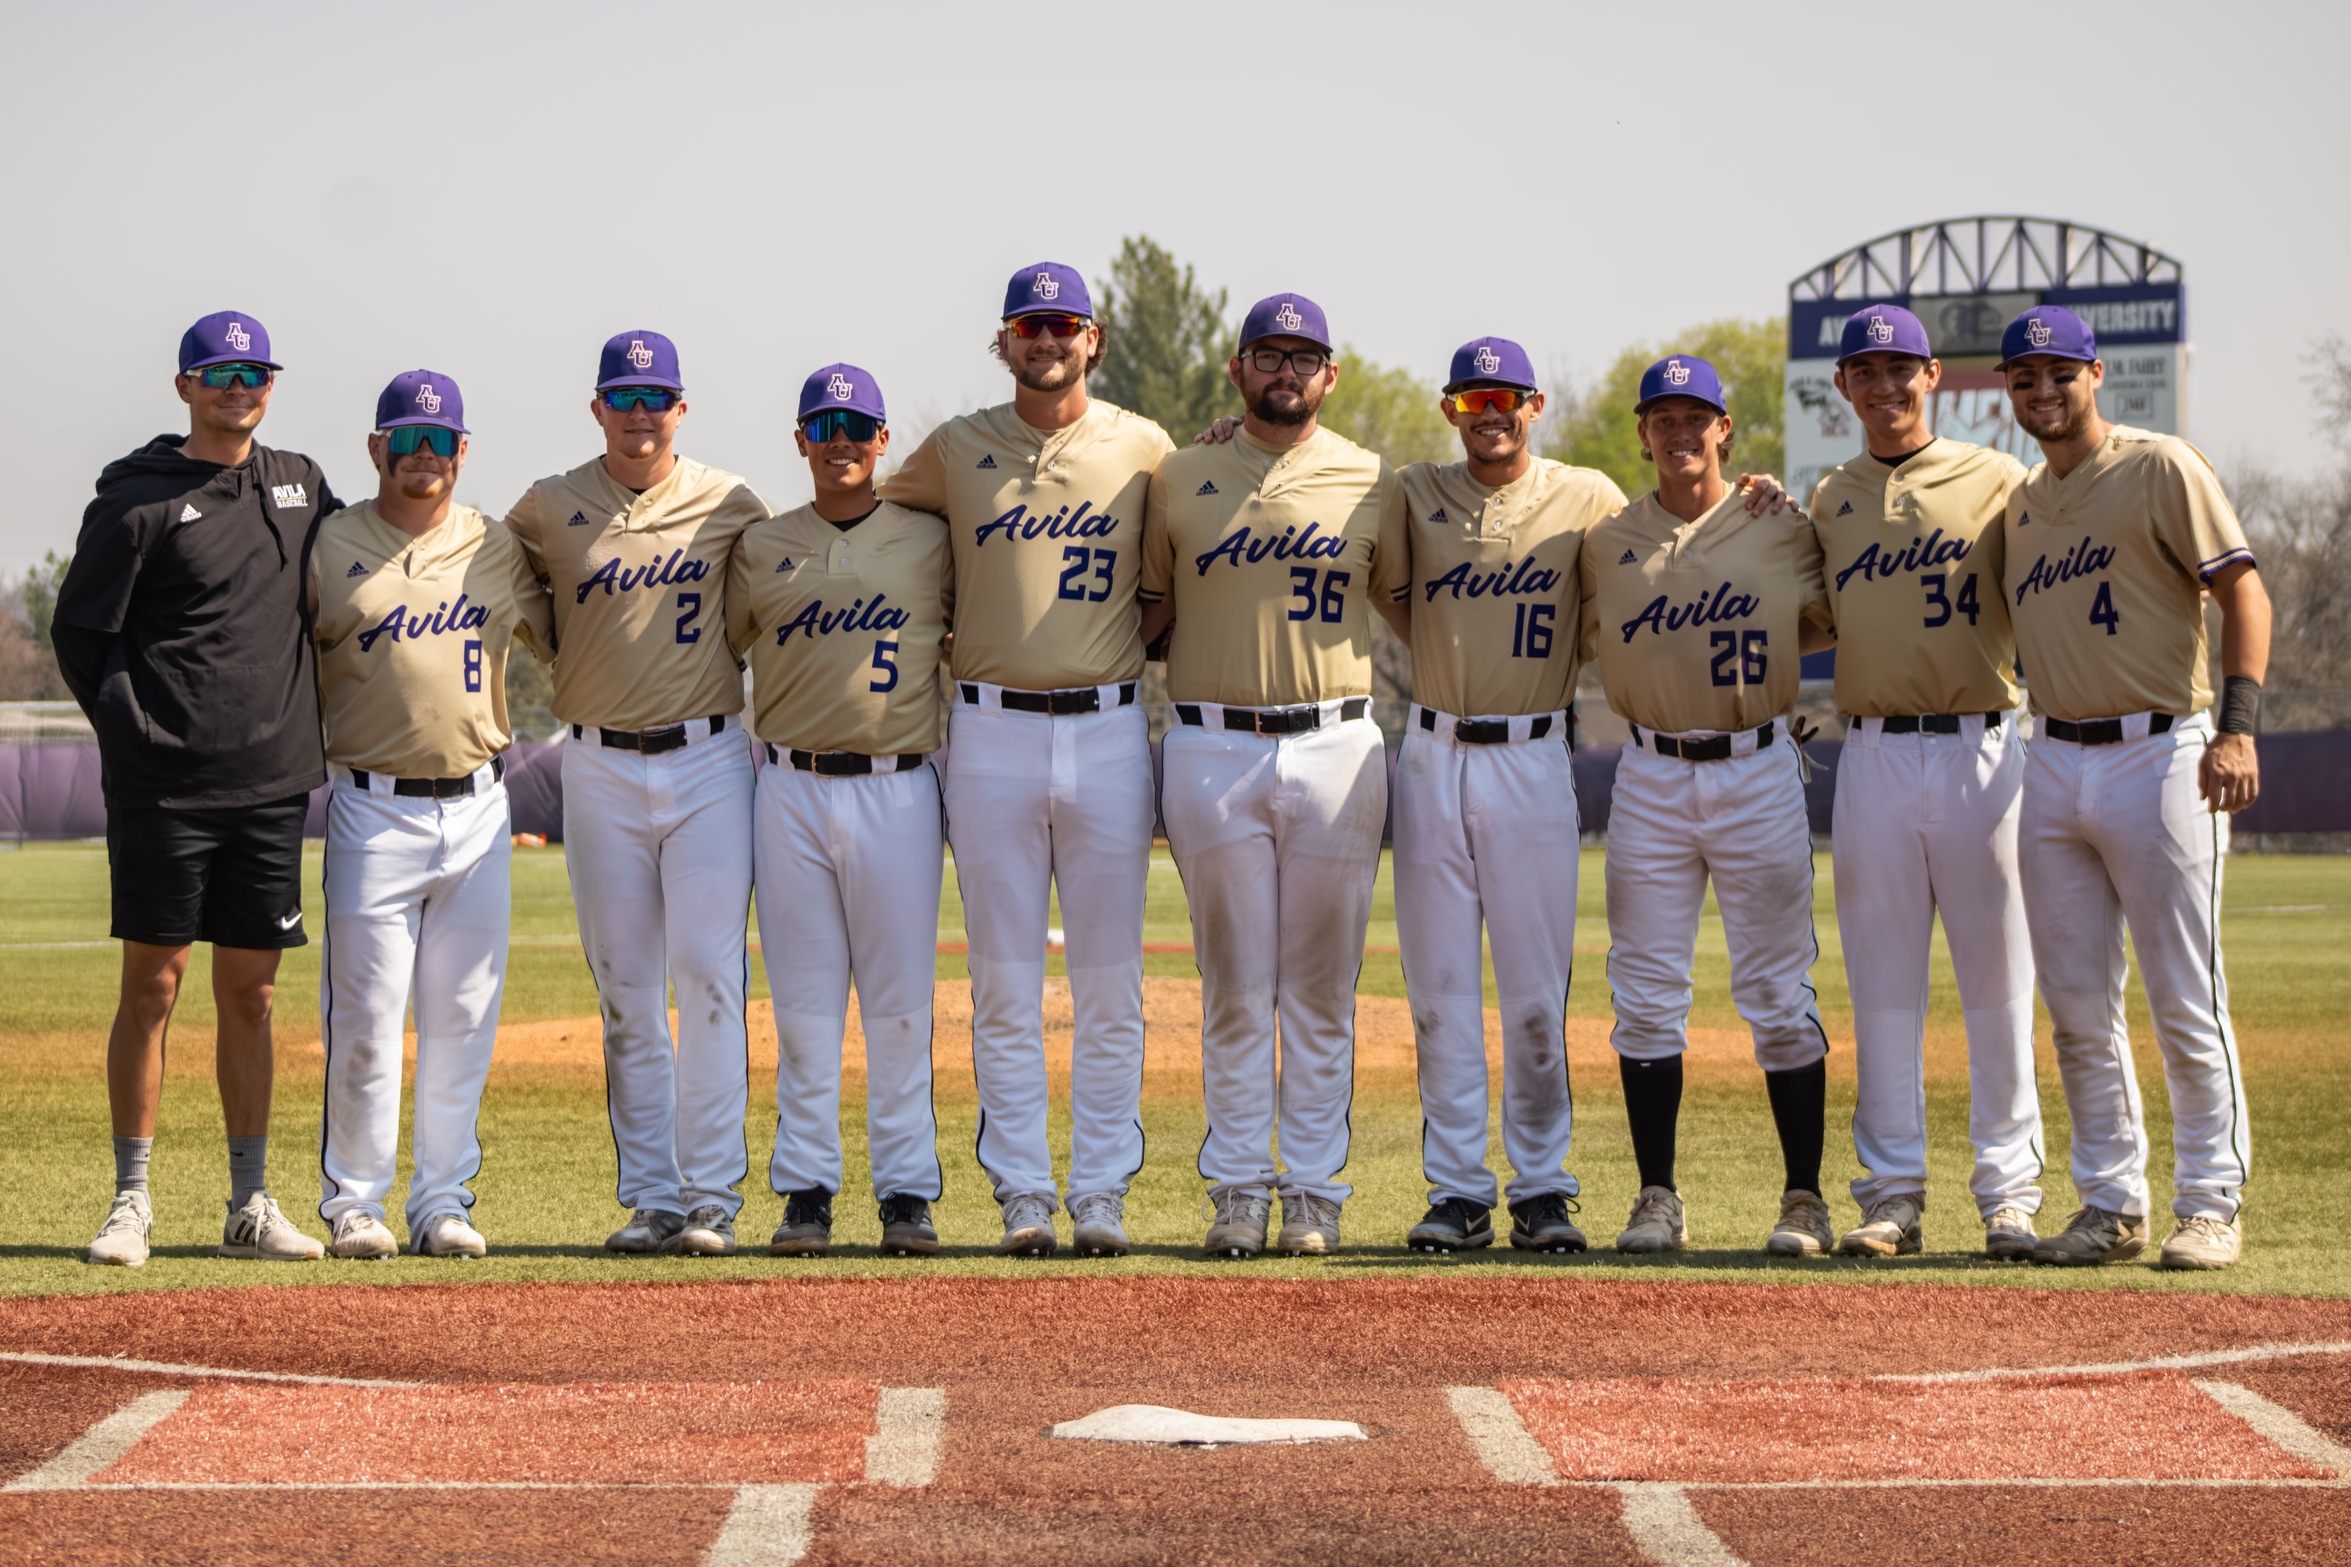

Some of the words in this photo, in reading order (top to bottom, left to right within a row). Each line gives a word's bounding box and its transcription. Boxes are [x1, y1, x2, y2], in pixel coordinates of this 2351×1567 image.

[1033, 272, 1059, 299] AU
[226, 323, 251, 350] AU
[1276, 304, 1301, 330] AU
[1867, 316, 1893, 343] AU
[2024, 319, 2051, 346] AU
[2070, 300, 2174, 332] VERSITY
[627, 340, 653, 368] AU
[1474, 347, 1500, 374] AU
[1664, 360, 1690, 385] AU
[416, 384, 441, 412] AU
[827, 373, 853, 400] AU
[271, 483, 306, 500] AVILA
[276, 498, 308, 509] BASEBALL
[975, 500, 1119, 547] Avila
[1196, 521, 1348, 576] Avila
[577, 548, 710, 604] Avila
[1057, 546, 1117, 603] 23
[1425, 555, 1561, 603] Avila
[1836, 528, 1973, 592] Avila
[2016, 536, 2115, 606] Avila
[676, 592, 702, 645] 2
[776, 593, 910, 646] Avila
[1288, 566, 1350, 624] 36
[1621, 581, 1760, 644] Avila
[1919, 574, 1980, 629] 34
[2089, 581, 2119, 636] 4
[358, 593, 491, 652] Avila
[1511, 603, 1556, 658] 16
[464, 640, 482, 693] 8
[869, 640, 899, 693] 5
[1709, 629, 1769, 687] 26
